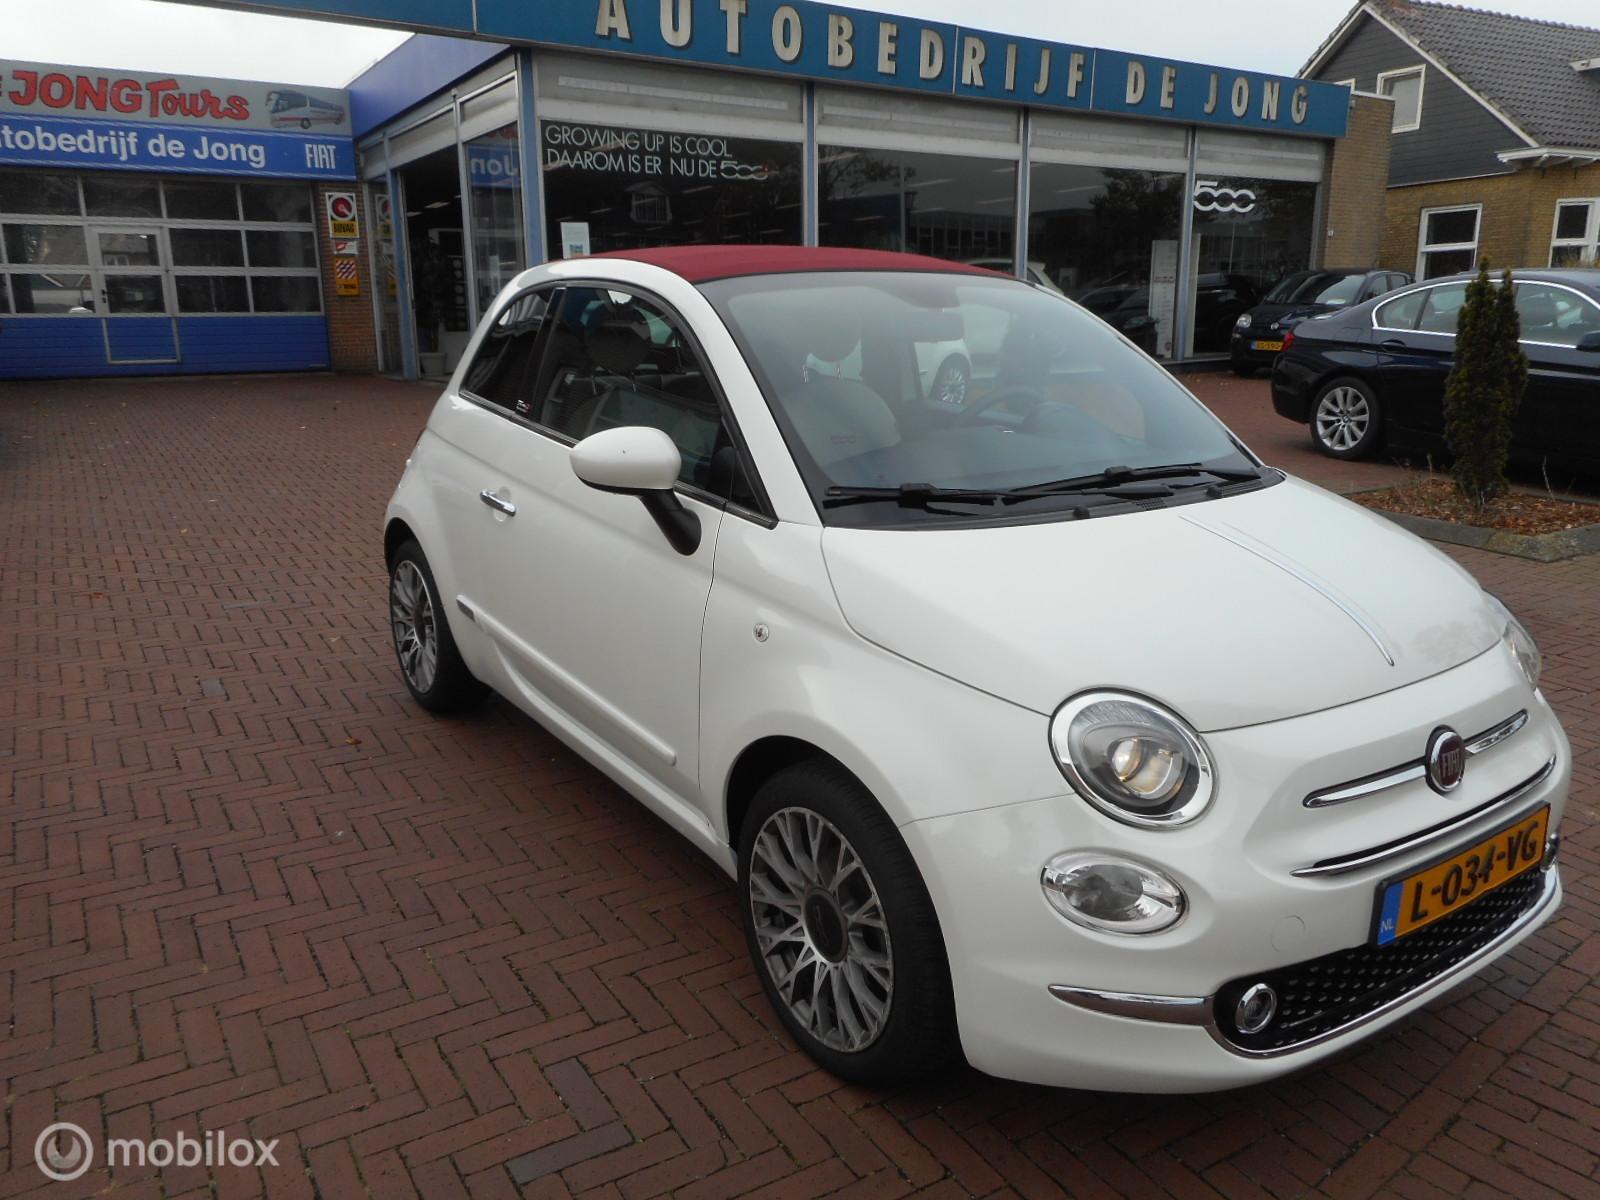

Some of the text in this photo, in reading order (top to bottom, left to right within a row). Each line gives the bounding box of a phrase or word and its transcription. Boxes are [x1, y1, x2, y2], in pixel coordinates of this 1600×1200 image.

[595, 0, 1308, 124] AUTOBEDRIJF DE JONG
[8, 70, 142, 113] JONG
[146, 78, 250, 120] Tours
[0, 125, 265, 168] tobedrijf de Jong
[545, 125, 641, 151] GROWING
[644, 133, 664, 152] UP
[669, 135, 682, 155] IS
[305, 143, 336, 169] FIAT
[547, 149, 626, 172] DAAROM
[628, 154, 641, 174] IS
[645, 155, 662, 175] ER
[670, 159, 695, 177] NU
[698, 160, 717, 178] DE
[1193, 180, 1257, 213] 500
[1442, 748, 1461, 778] FIAT
[1410, 821, 1539, 922] L-034-VG
[1380, 918, 1394, 934] NL
